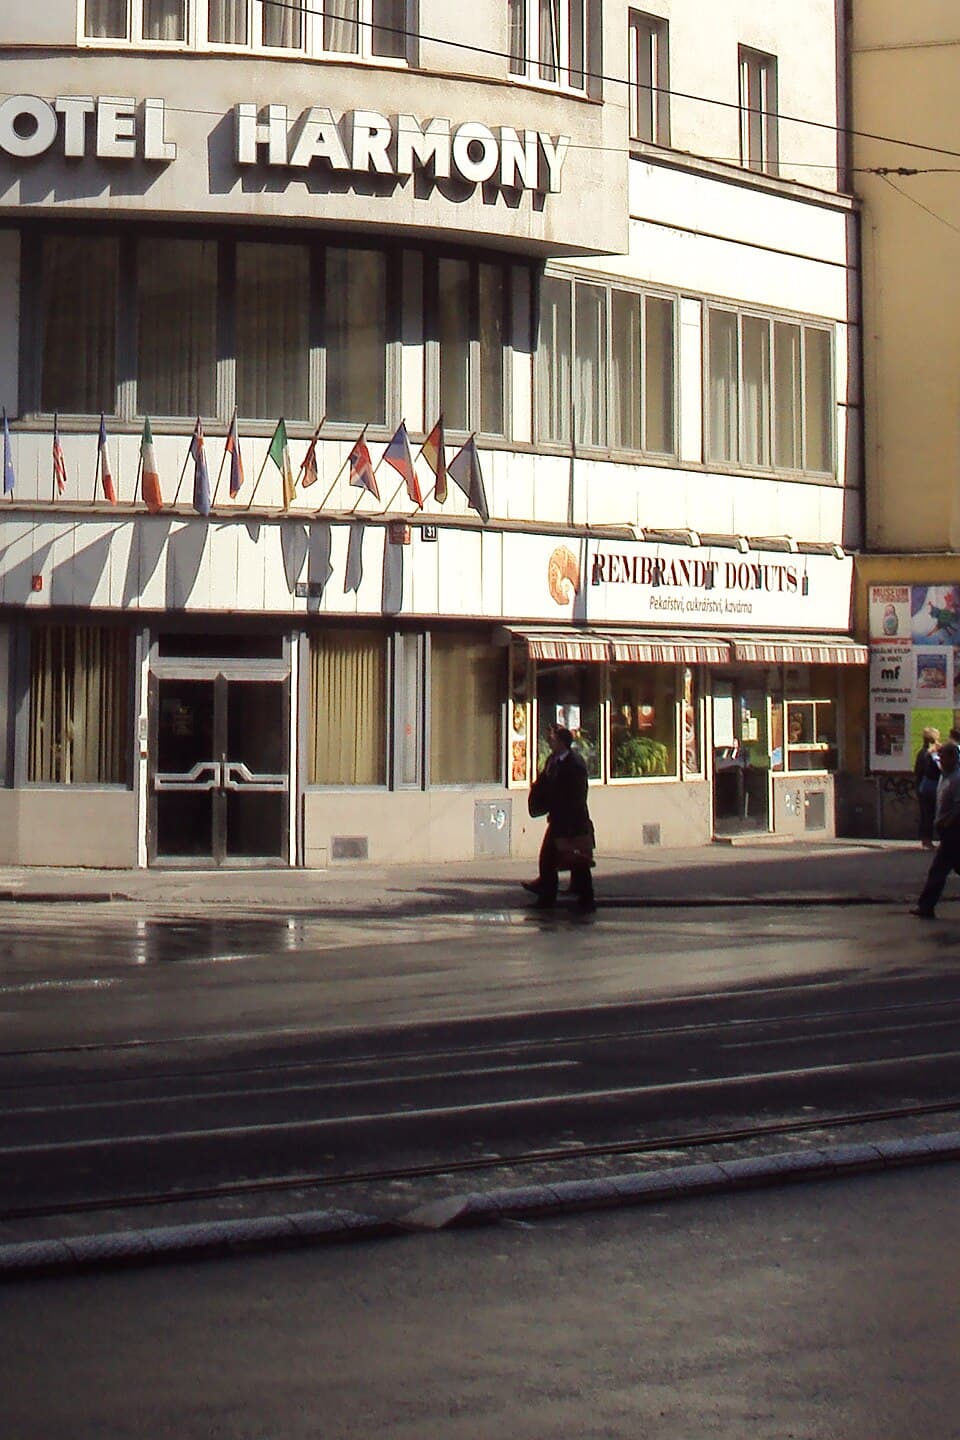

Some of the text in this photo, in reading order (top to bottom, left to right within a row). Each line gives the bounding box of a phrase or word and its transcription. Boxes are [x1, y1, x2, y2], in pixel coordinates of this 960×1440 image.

[234, 103, 572, 194] HARMONY
[592, 553, 798, 593] REMBRANDT DONUTS
[872, 588, 909, 599] MUSEUM
[725, 598, 753, 614] kavárna
[881, 665, 901, 680] mf
